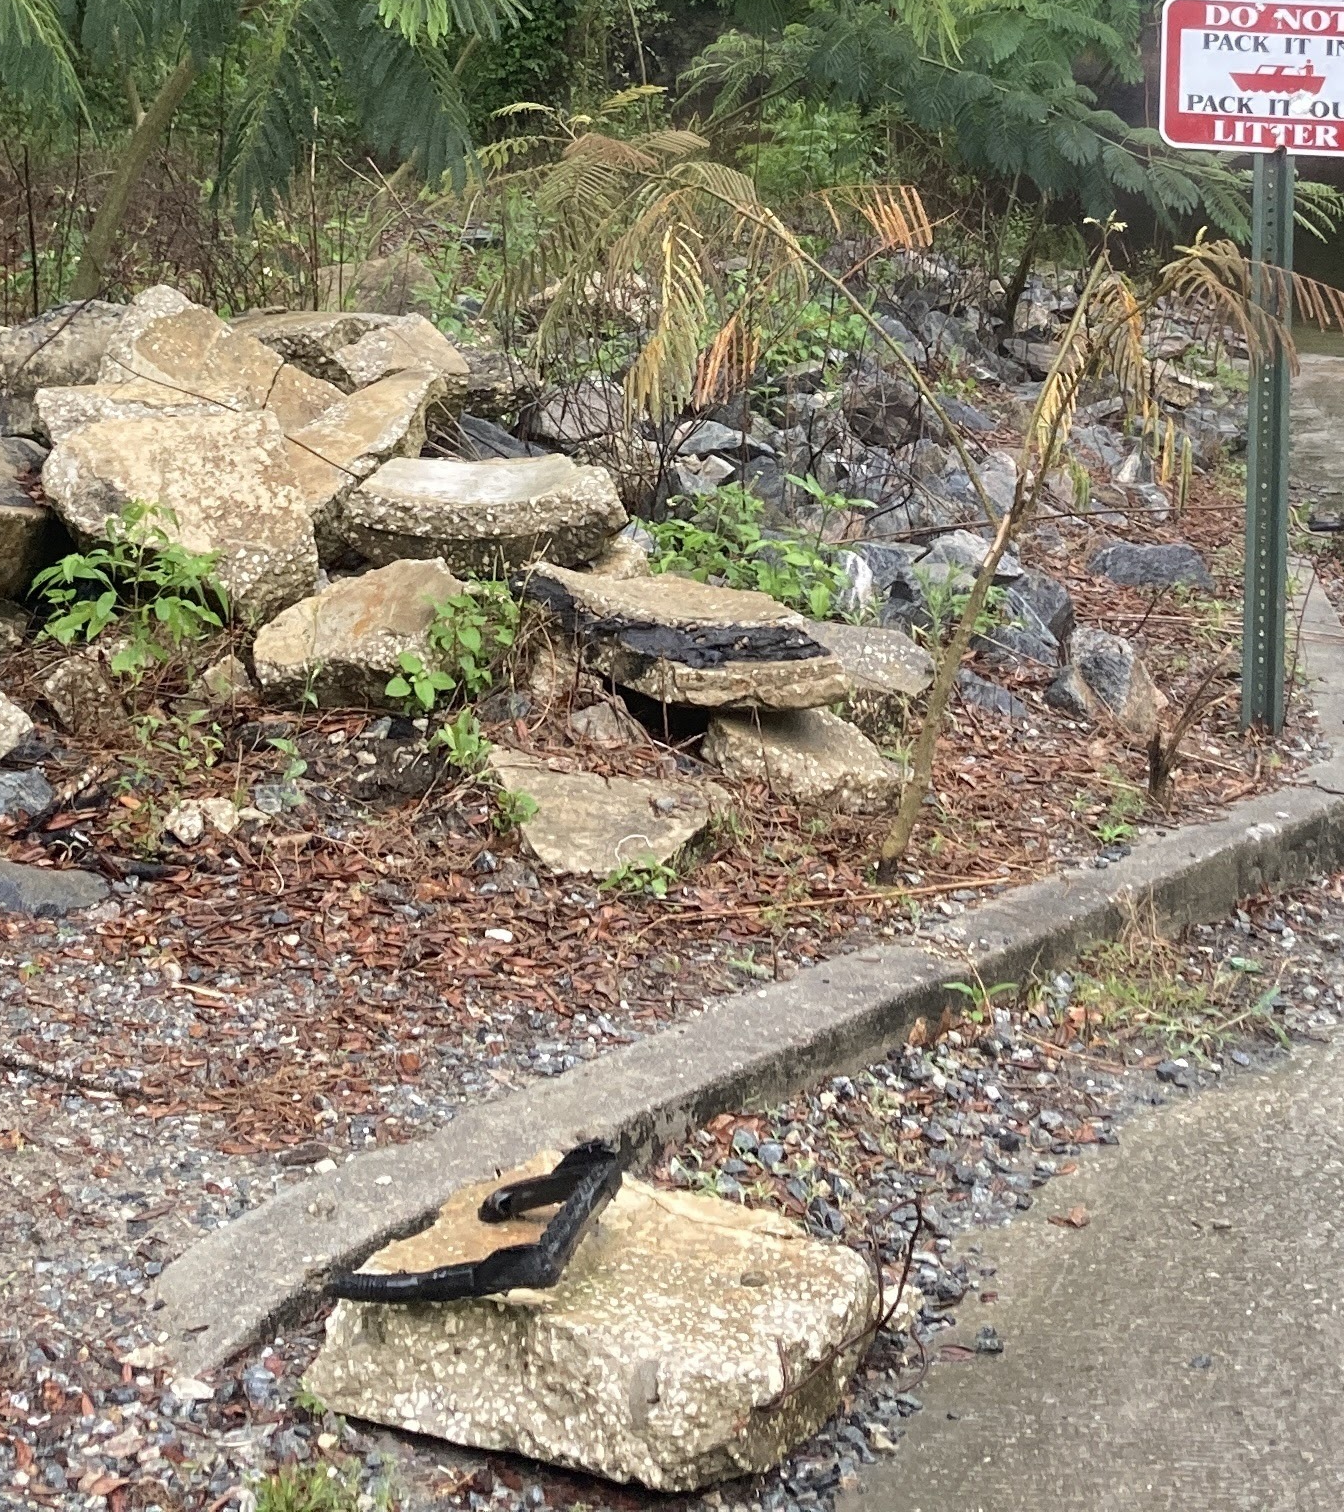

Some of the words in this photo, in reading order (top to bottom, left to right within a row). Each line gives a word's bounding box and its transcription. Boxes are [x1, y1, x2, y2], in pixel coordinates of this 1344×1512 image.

[1205, 4, 1259, 27] DO
[1203, 33, 1269, 53] PACK
[1285, 37, 1311, 55] IT
[1187, 94, 1254, 114] PACK
[1269, 99, 1293, 116] IT
[1213, 120, 1339, 148] LITTER
